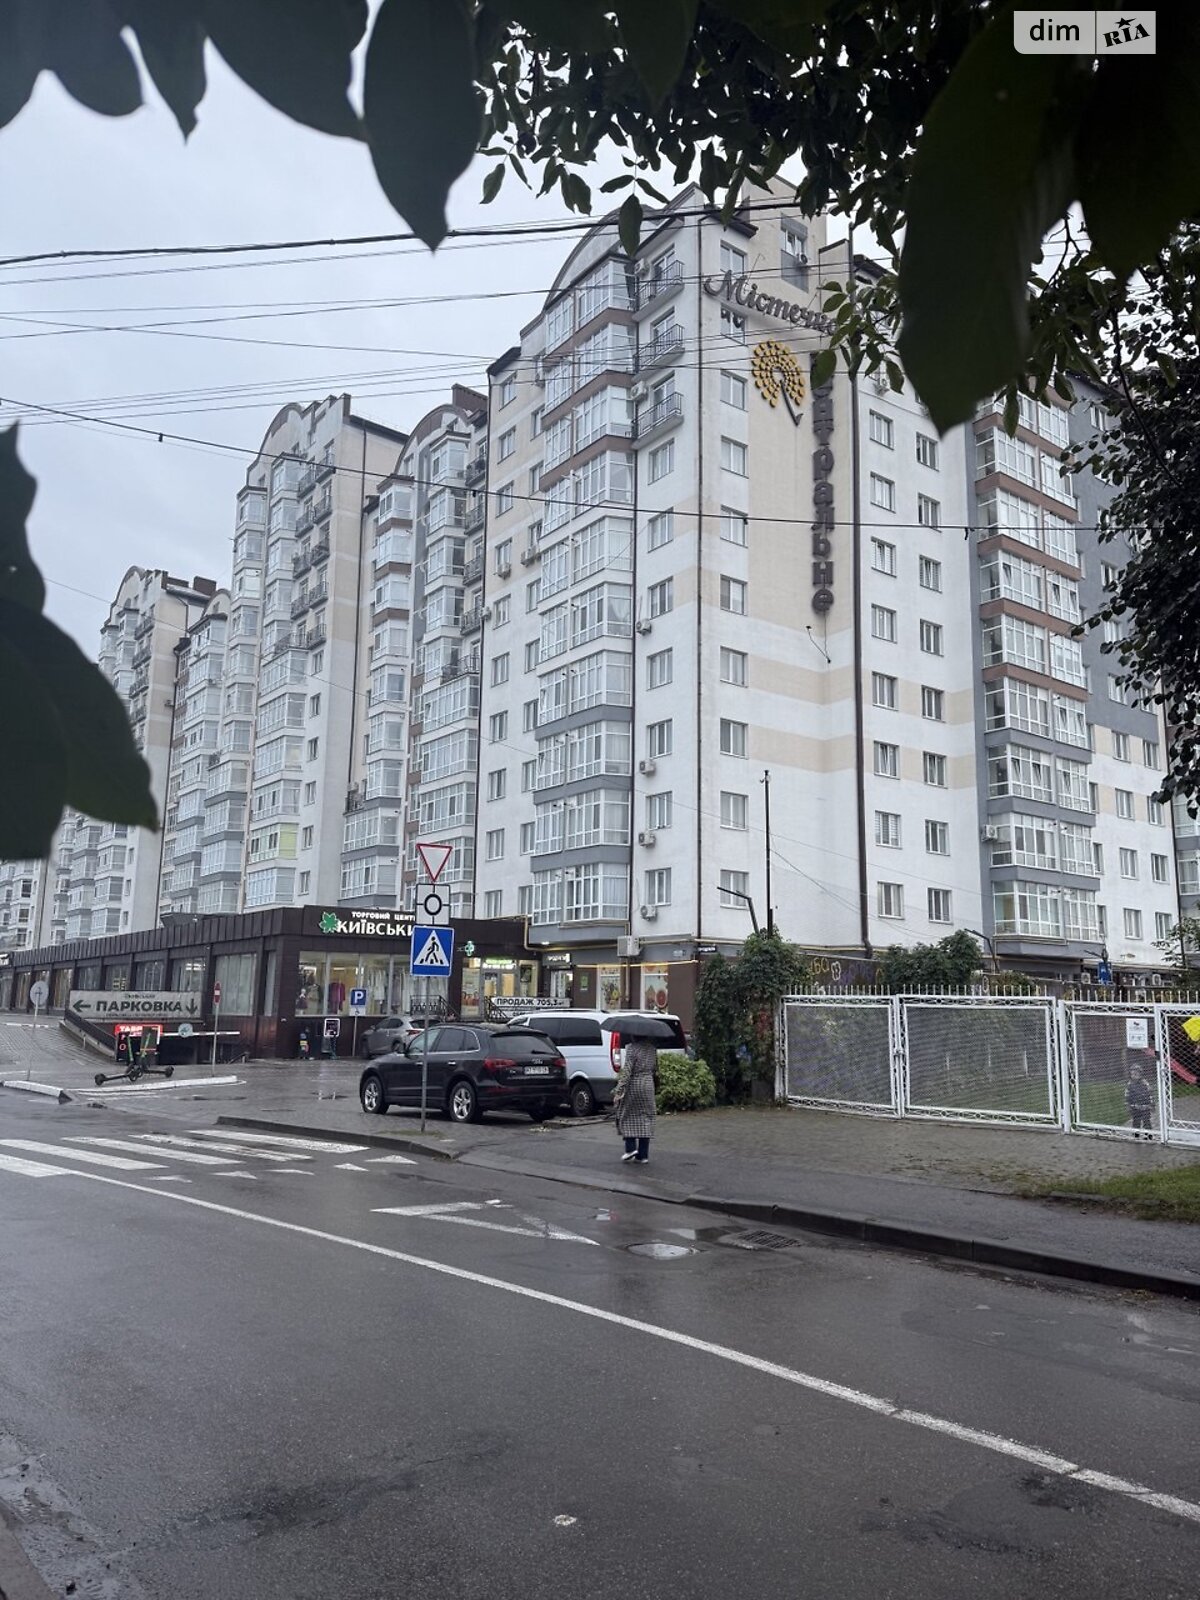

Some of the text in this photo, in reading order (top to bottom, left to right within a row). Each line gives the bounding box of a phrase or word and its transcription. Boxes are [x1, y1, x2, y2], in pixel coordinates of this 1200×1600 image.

[810, 353, 835, 613] ентральне
[351, 911, 415, 922] ТОРГОВИЙ ЦЕНТ
[96, 1000, 182, 1012] ПАРКОВКА
[496, 998, 535, 1006] ПРОДАЖ
